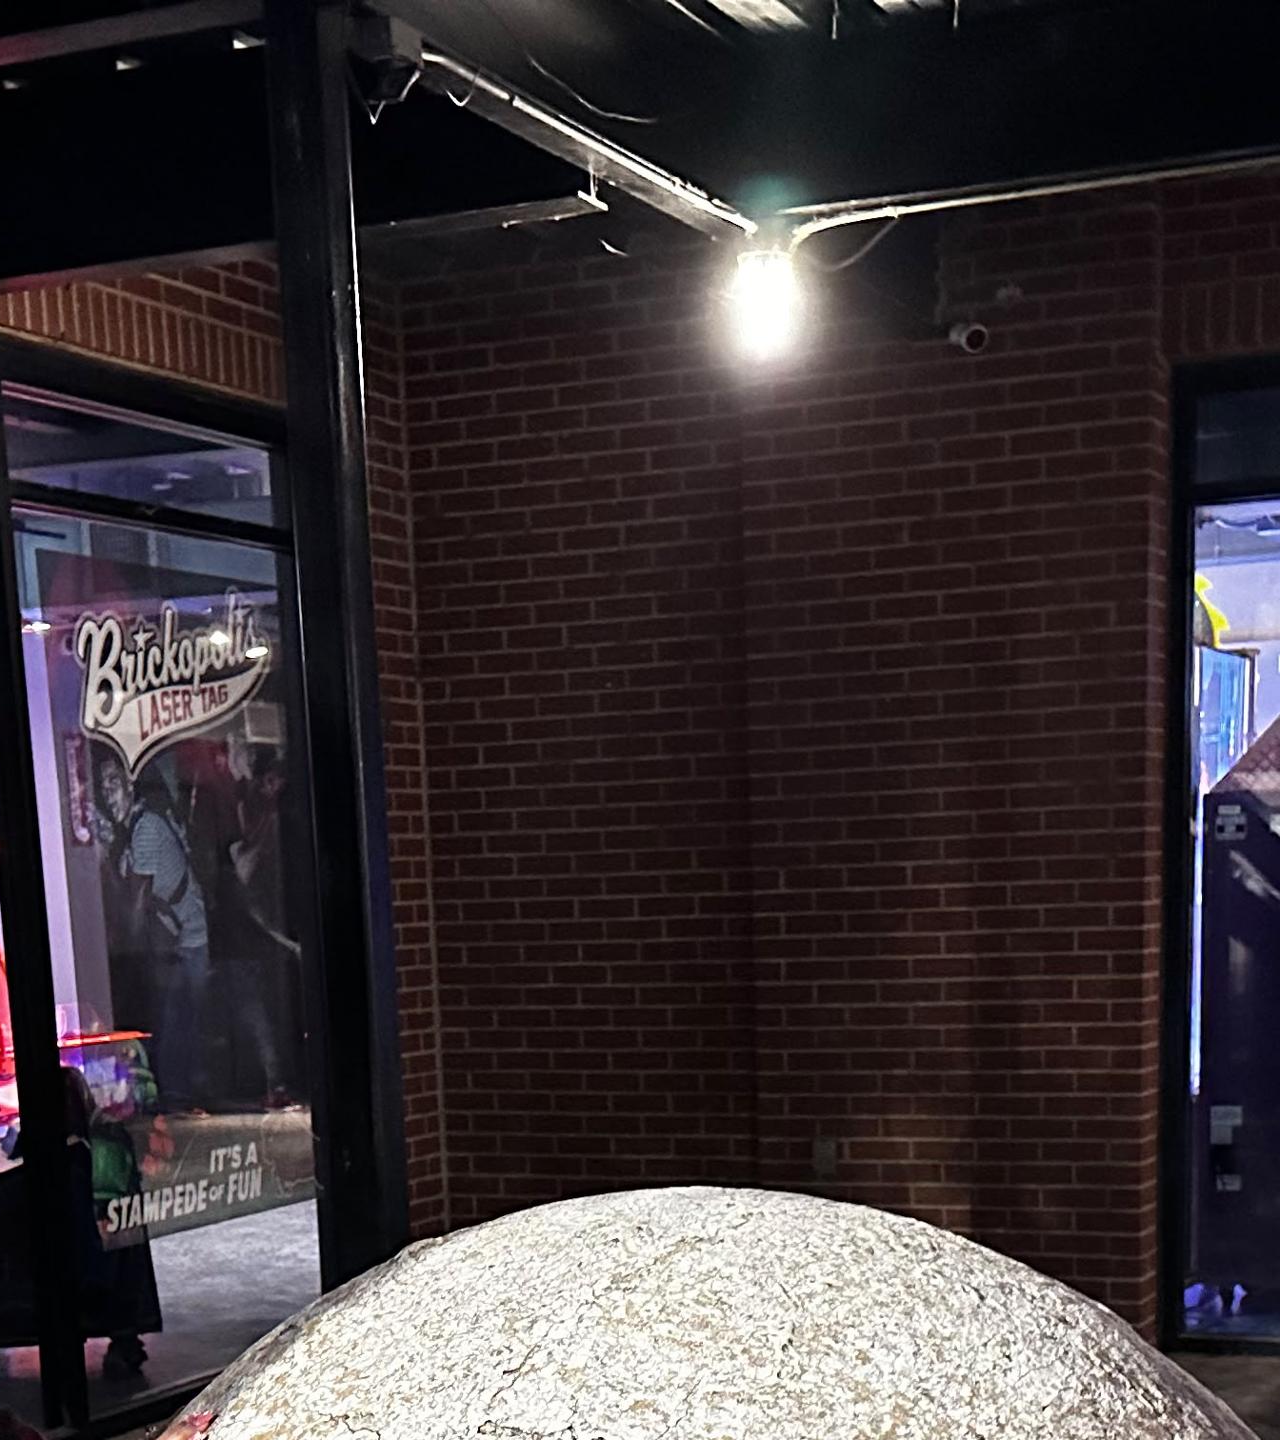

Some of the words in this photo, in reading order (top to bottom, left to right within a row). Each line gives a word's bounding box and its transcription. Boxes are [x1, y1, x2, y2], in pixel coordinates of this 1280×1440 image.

[77, 593, 267, 728] Brickopolis
[137, 687, 194, 741] LASER
[200, 683, 228, 711] TAG
[210, 1144, 242, 1174] IT'S
[245, 1141, 259, 1167] A
[106, 1179, 208, 1233] STAMPEDE
[227, 1166, 263, 1205] FUN
